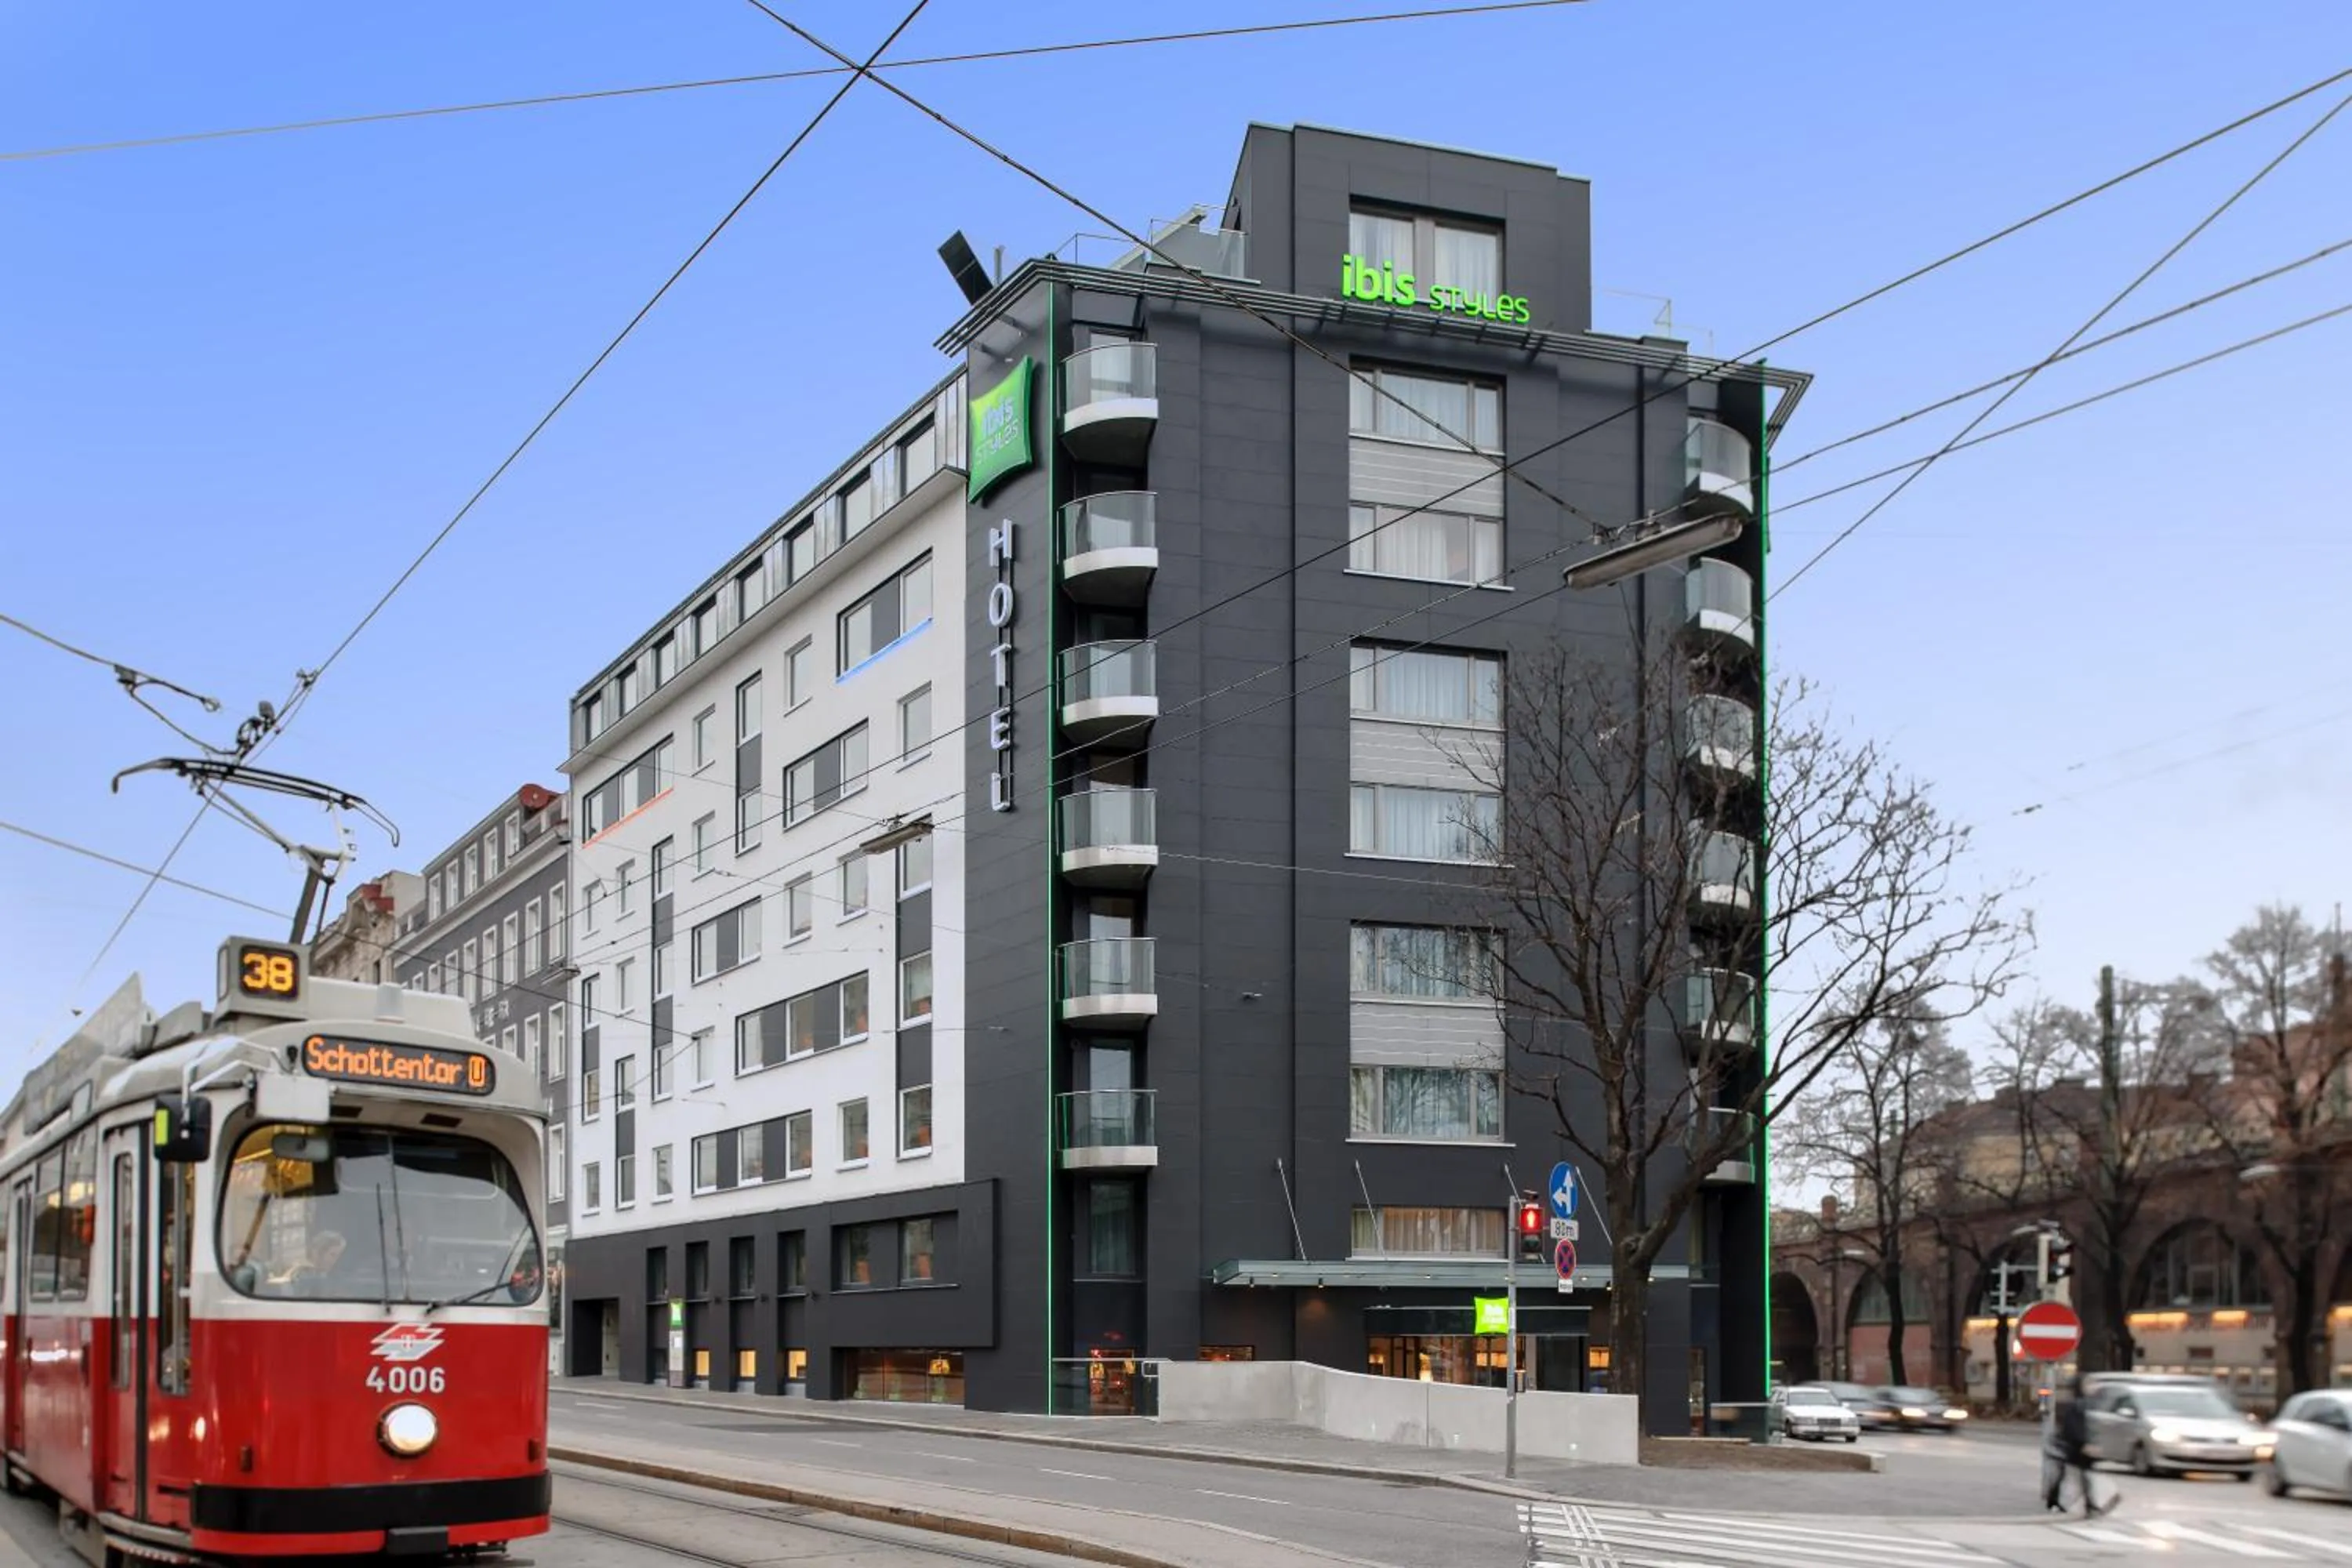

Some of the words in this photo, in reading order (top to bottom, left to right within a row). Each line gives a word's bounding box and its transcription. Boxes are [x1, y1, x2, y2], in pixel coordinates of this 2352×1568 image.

[1342, 253, 1416, 306] ibis
[989, 518, 1014, 812] HOTEL
[244, 952, 294, 993] 38
[307, 1036, 463, 1085] Schottentor
[365, 1365, 446, 1393] 4006
